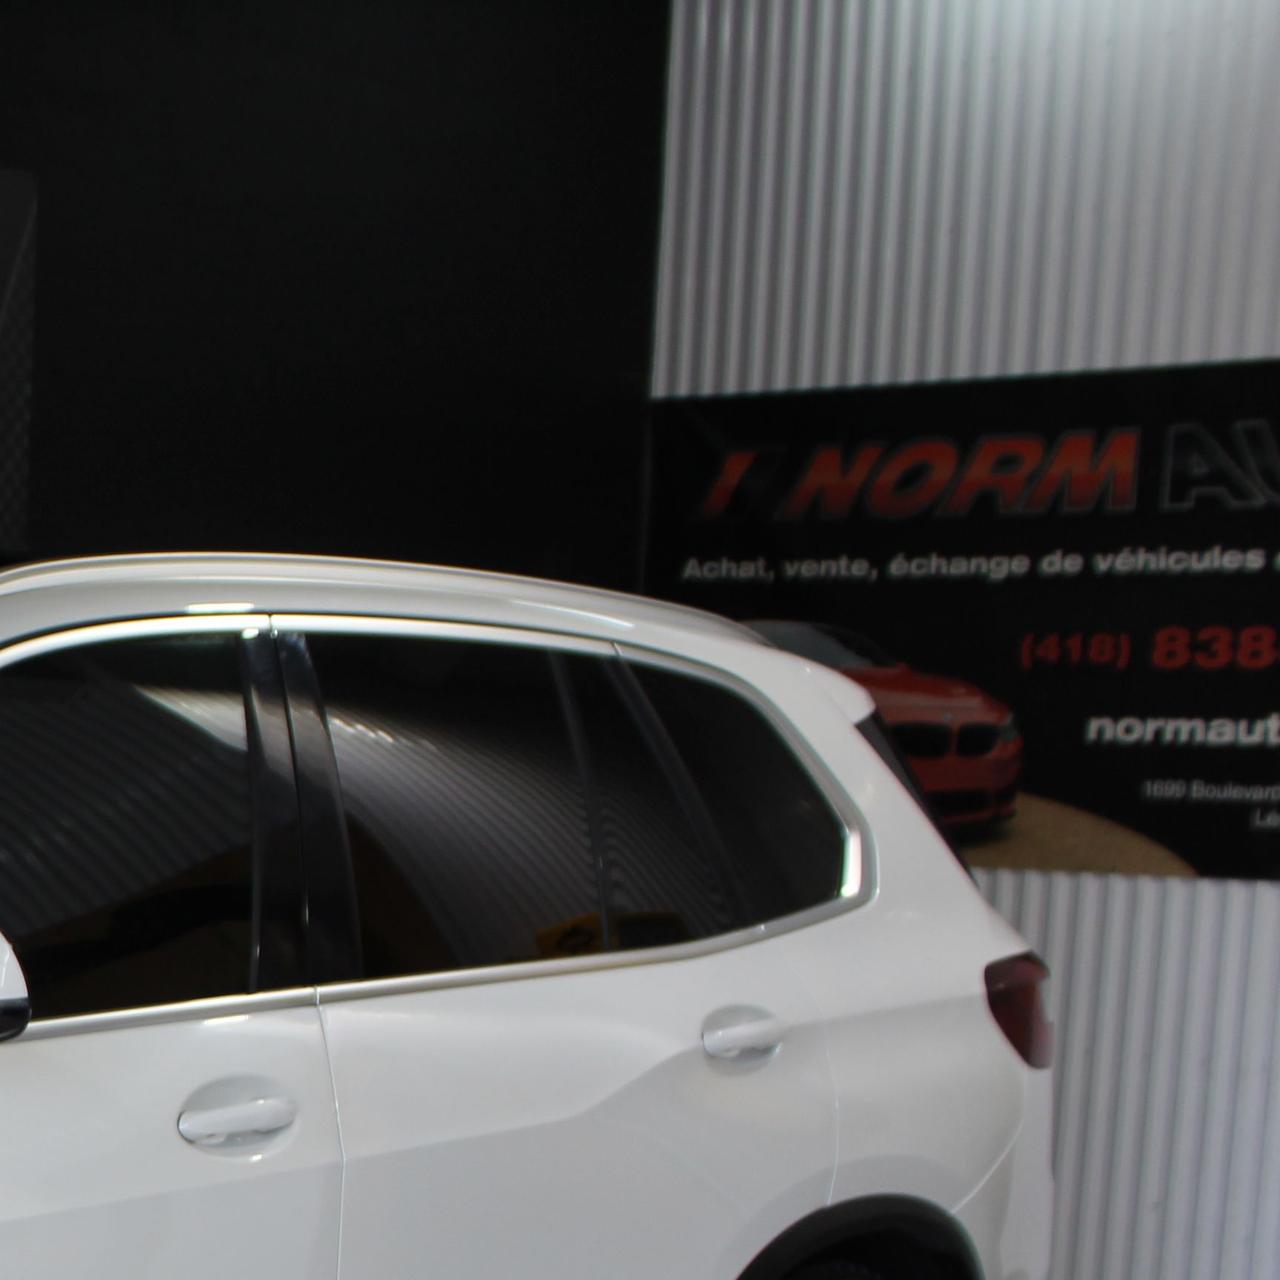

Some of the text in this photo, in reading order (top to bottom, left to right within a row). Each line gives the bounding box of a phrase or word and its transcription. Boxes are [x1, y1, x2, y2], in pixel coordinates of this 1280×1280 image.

[782, 427, 1140, 514] NORM
[681, 556, 775, 580] Achat,
[784, 553, 878, 580] vente,
[888, 552, 1031, 581] échange
[1039, 548, 1084, 575] de
[1093, 545, 1267, 575] véhicules
[1020, 633, 1131, 669] (418)
